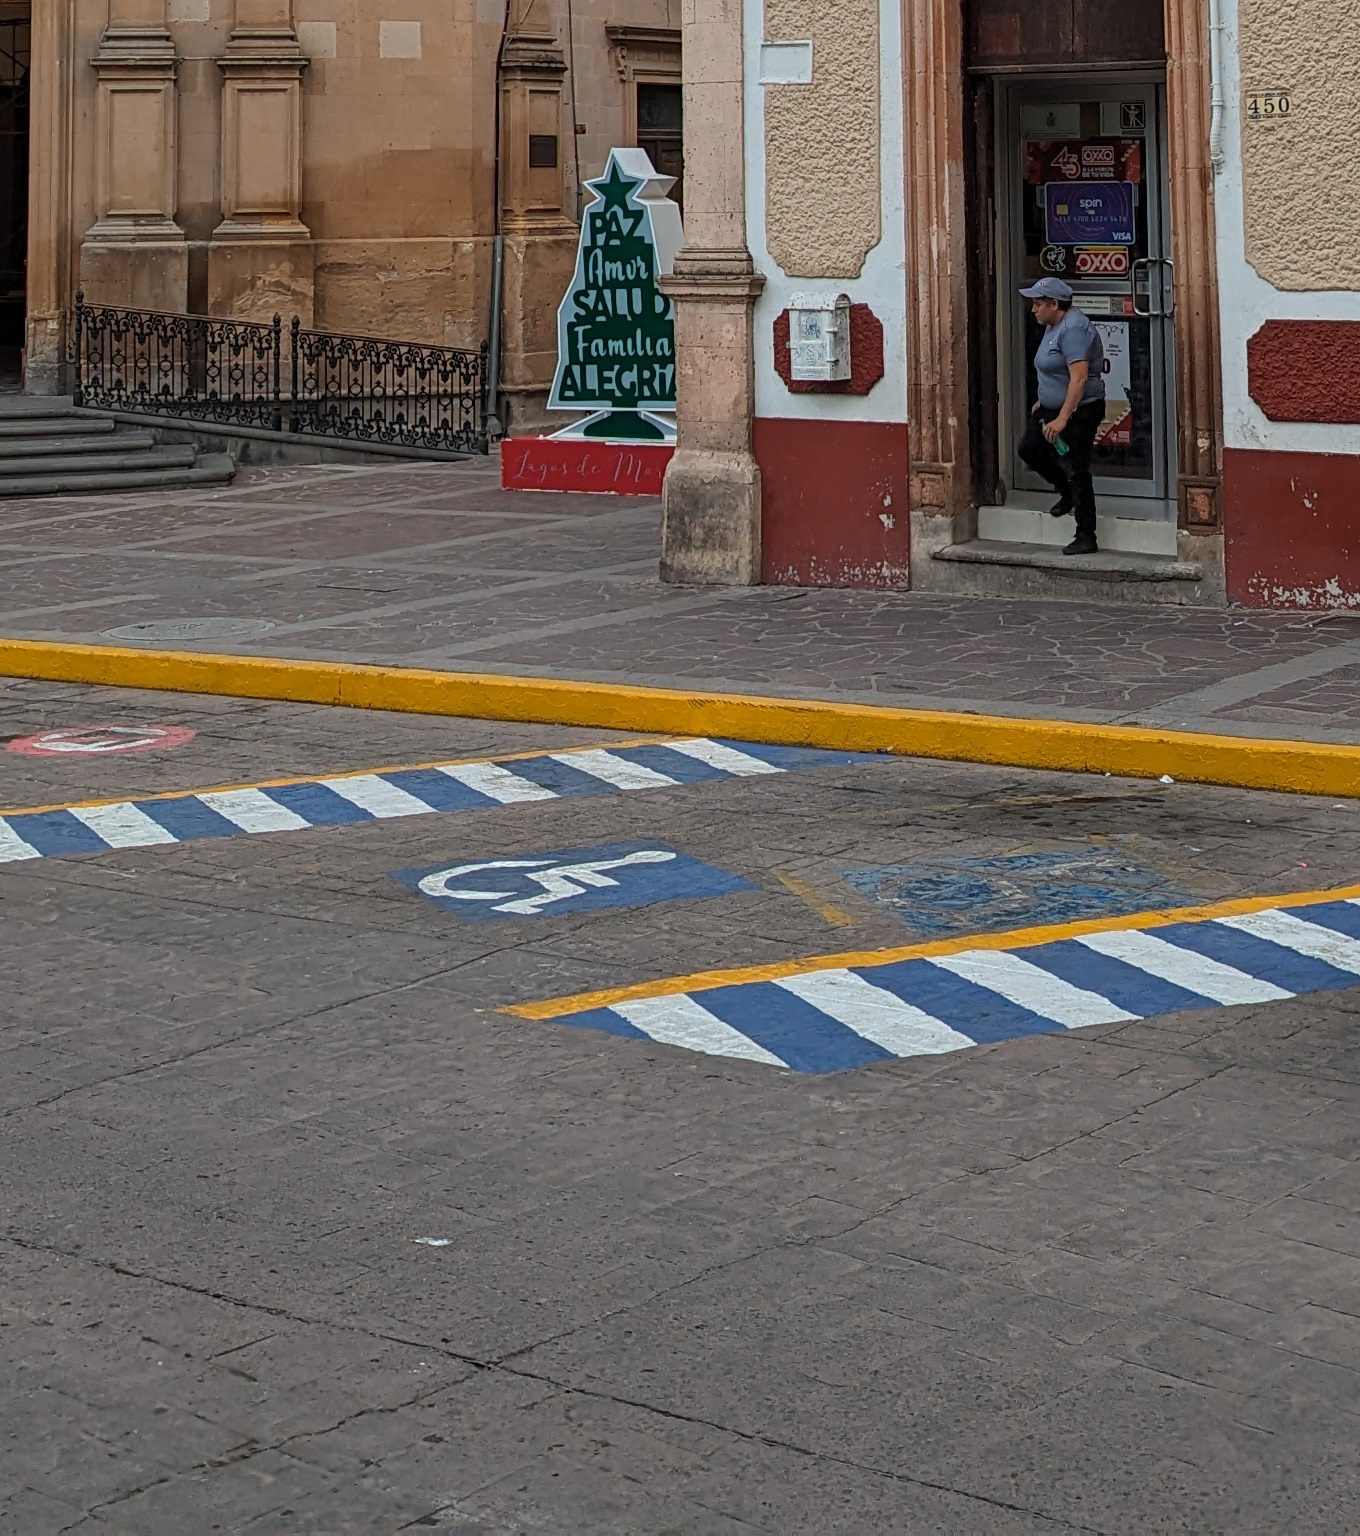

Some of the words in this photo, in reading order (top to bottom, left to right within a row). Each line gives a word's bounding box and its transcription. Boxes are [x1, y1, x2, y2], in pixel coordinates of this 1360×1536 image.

[1247, 96, 1290, 115] 450
[1083, 148, 1113, 162] OXXO
[1079, 198, 1103, 209] spin
[589, 210, 645, 246] PAZ
[1111, 232, 1132, 241] VISA
[588, 248, 649, 287] Amor
[1075, 253, 1126, 272] OXXO
[572, 288, 671, 322] SALUD
[573, 325, 673, 362] Familia
[513, 449, 568, 482] Lagos
[576, 454, 601, 477] de
[610, 451, 663, 482] Mor
